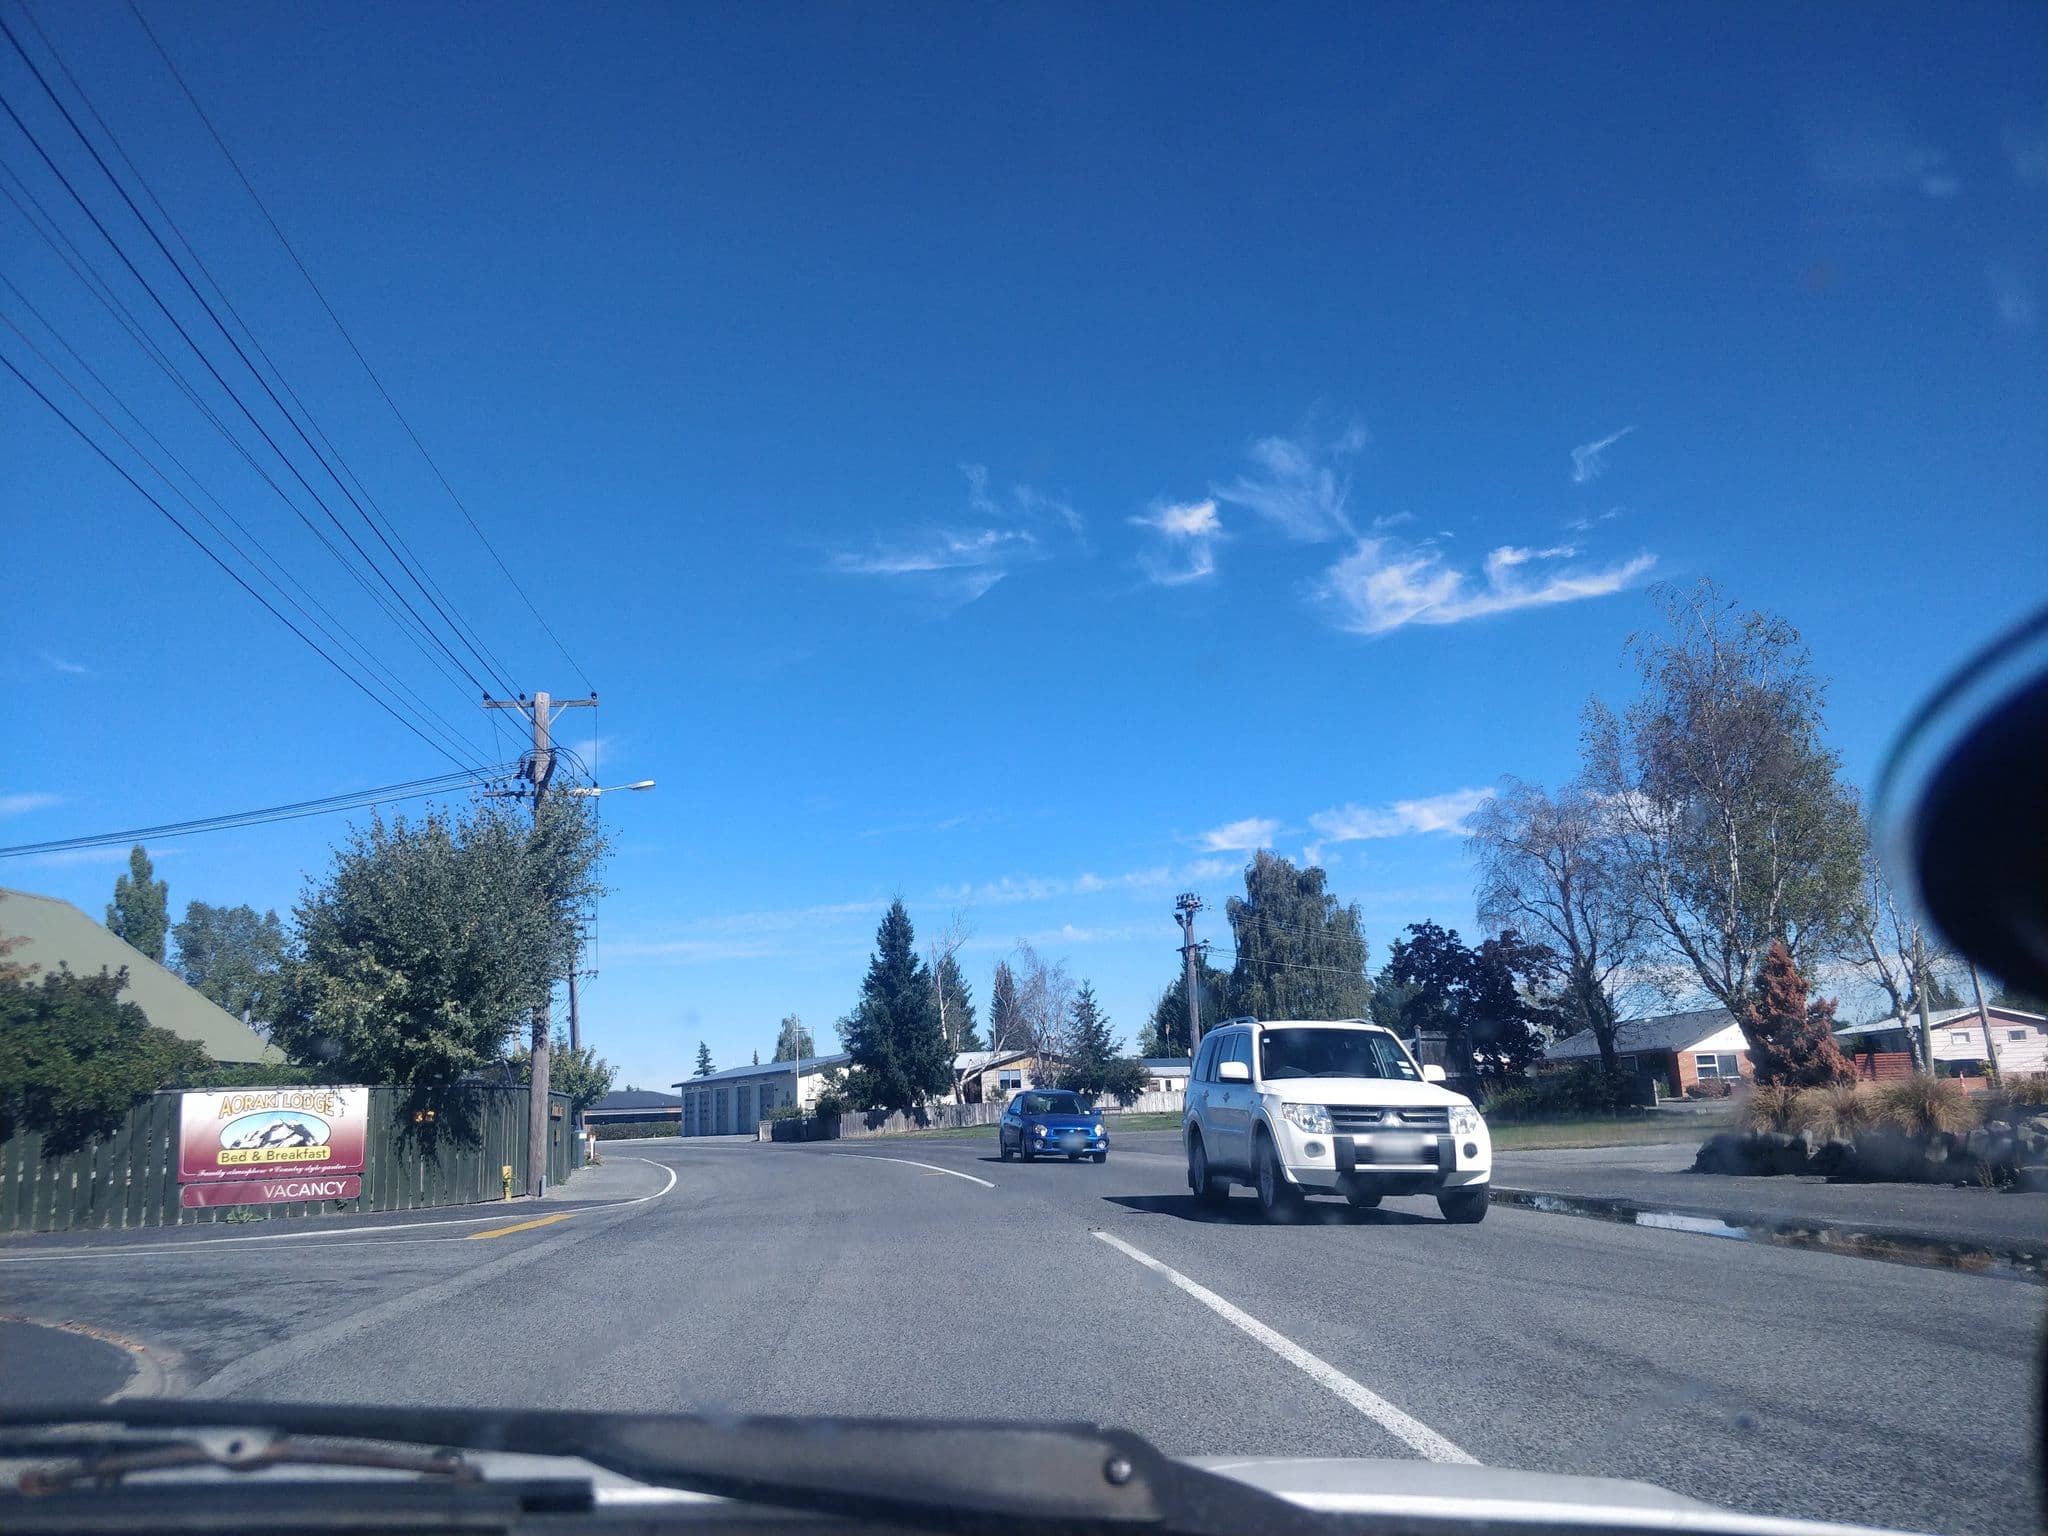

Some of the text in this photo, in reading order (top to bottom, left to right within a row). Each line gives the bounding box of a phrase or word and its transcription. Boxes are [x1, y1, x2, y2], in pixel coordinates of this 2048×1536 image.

[218, 1092, 336, 1120] AORAKI LODGE
[221, 1148, 328, 1163] Bed & Breakfast
[263, 1181, 347, 1198] VACANCY
